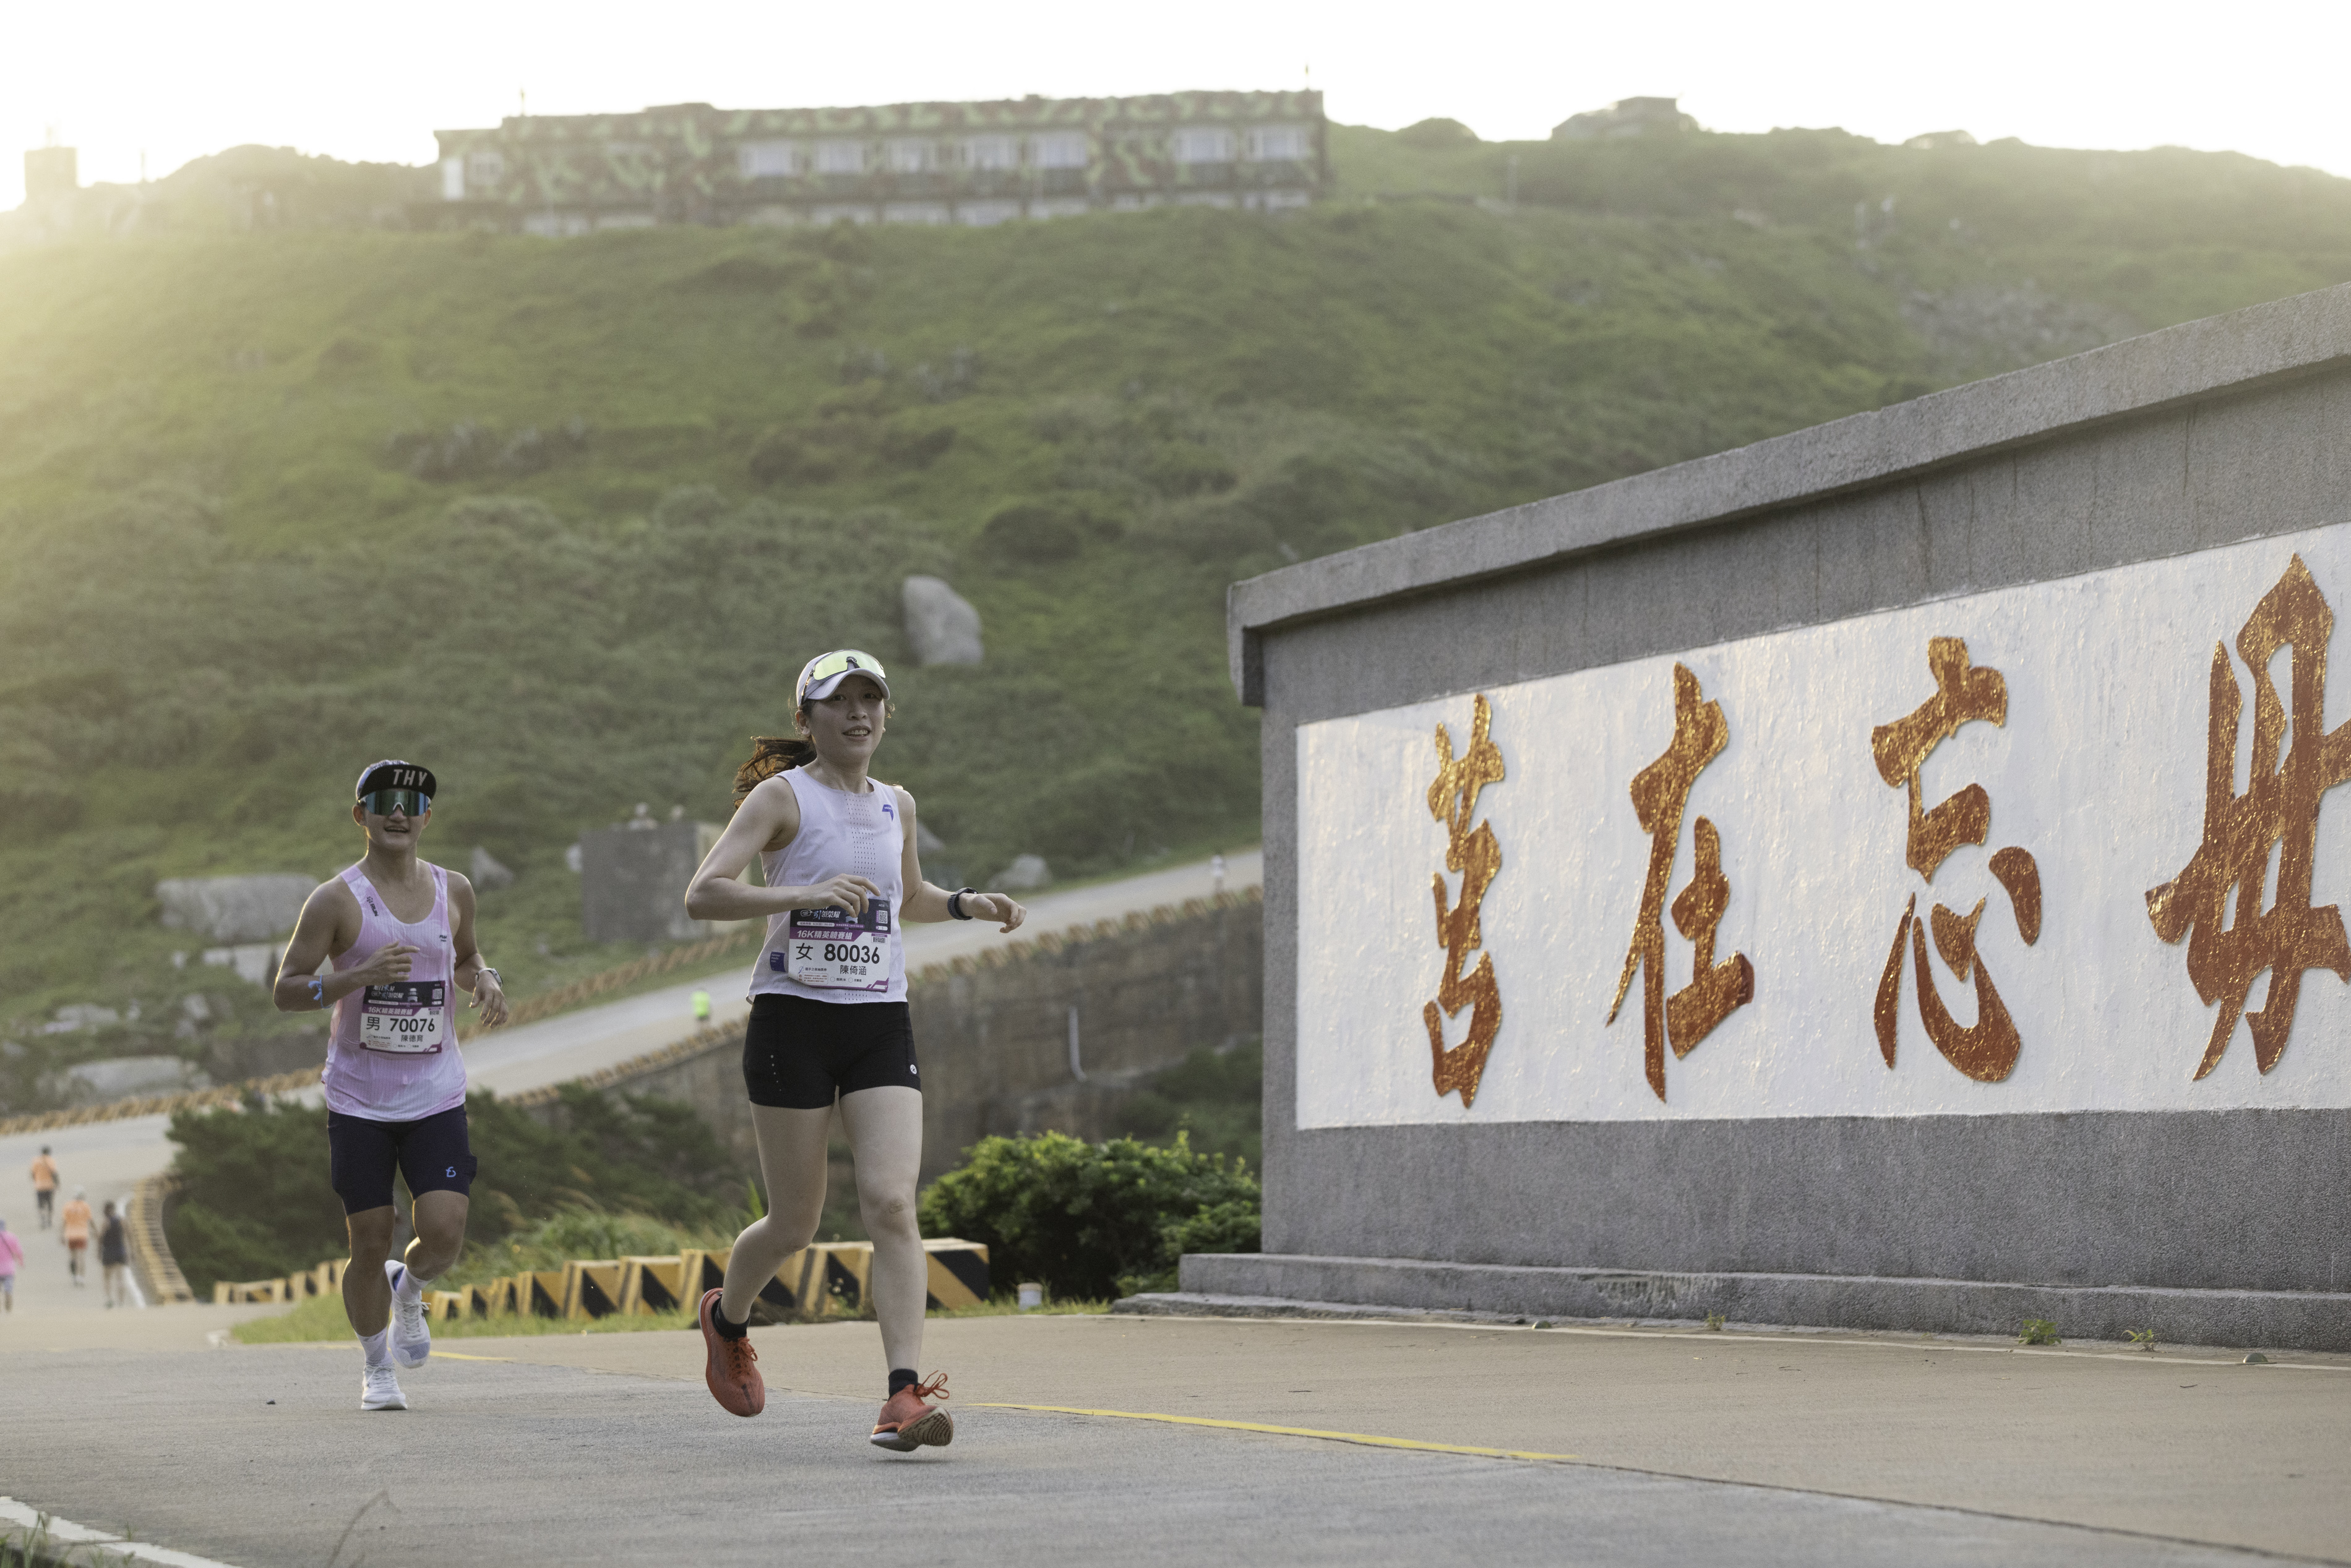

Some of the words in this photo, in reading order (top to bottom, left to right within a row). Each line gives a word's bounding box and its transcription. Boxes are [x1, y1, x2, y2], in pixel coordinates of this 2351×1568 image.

[797, 930, 853, 940] 16K精英競賽組
[796, 943, 814, 961] 女
[824, 943, 880, 964] 80036
[840, 965, 867, 975] 陳倚涵
[366, 1016, 380, 1031] 男
[390, 1017, 435, 1032] 70076
